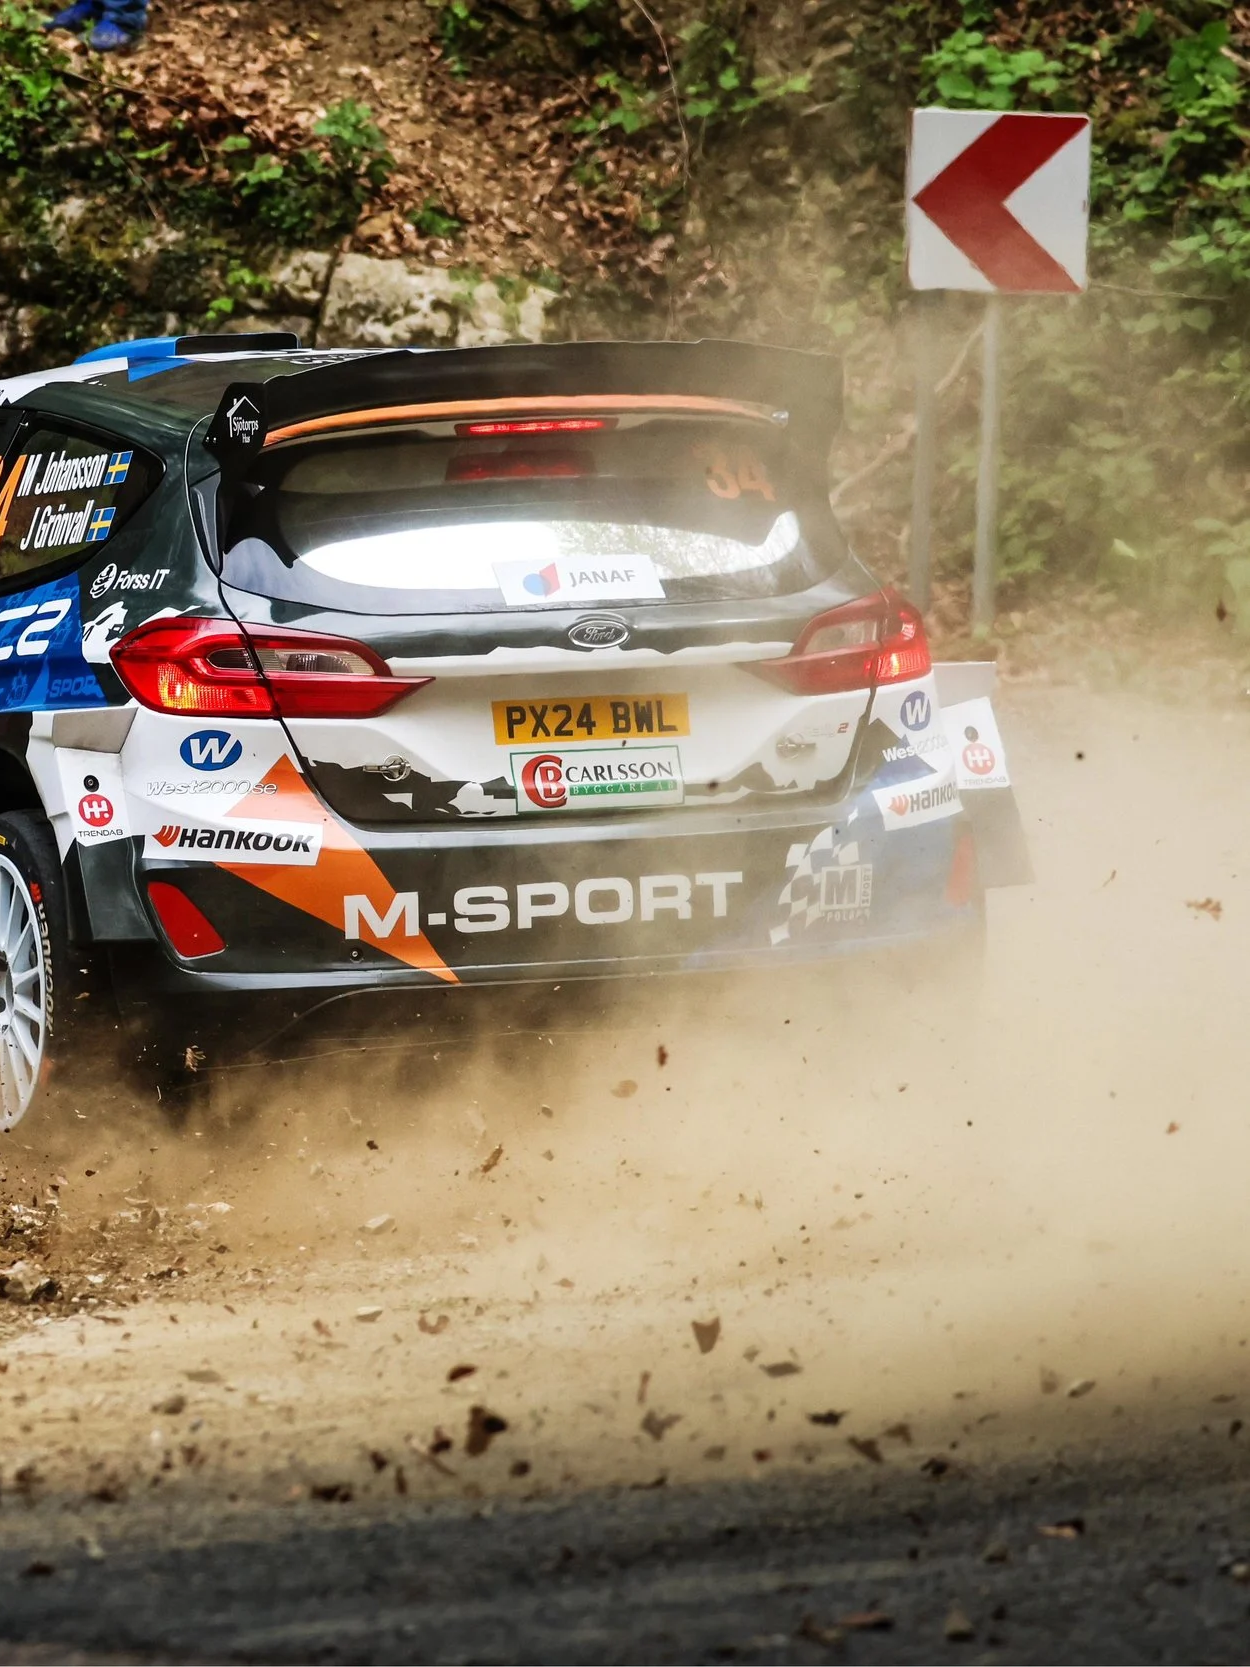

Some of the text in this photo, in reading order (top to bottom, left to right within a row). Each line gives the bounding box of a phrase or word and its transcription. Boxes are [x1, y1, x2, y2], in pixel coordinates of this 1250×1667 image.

[17, 450, 107, 498] M Johansson
[20, 499, 95, 551] J Grönvall
[112, 568, 170, 590] Forss IT
[568, 569, 637, 588] JANAF
[584, 625, 616, 643] Ford
[505, 701, 678, 740] PX24 BWL
[189, 733, 239, 765] W
[565, 761, 674, 784] CARLSSON
[572, 781, 676, 796] BYGGARE AB
[78, 828, 124, 838] TRENDAB
[343, 871, 743, 940] M-SPORT
